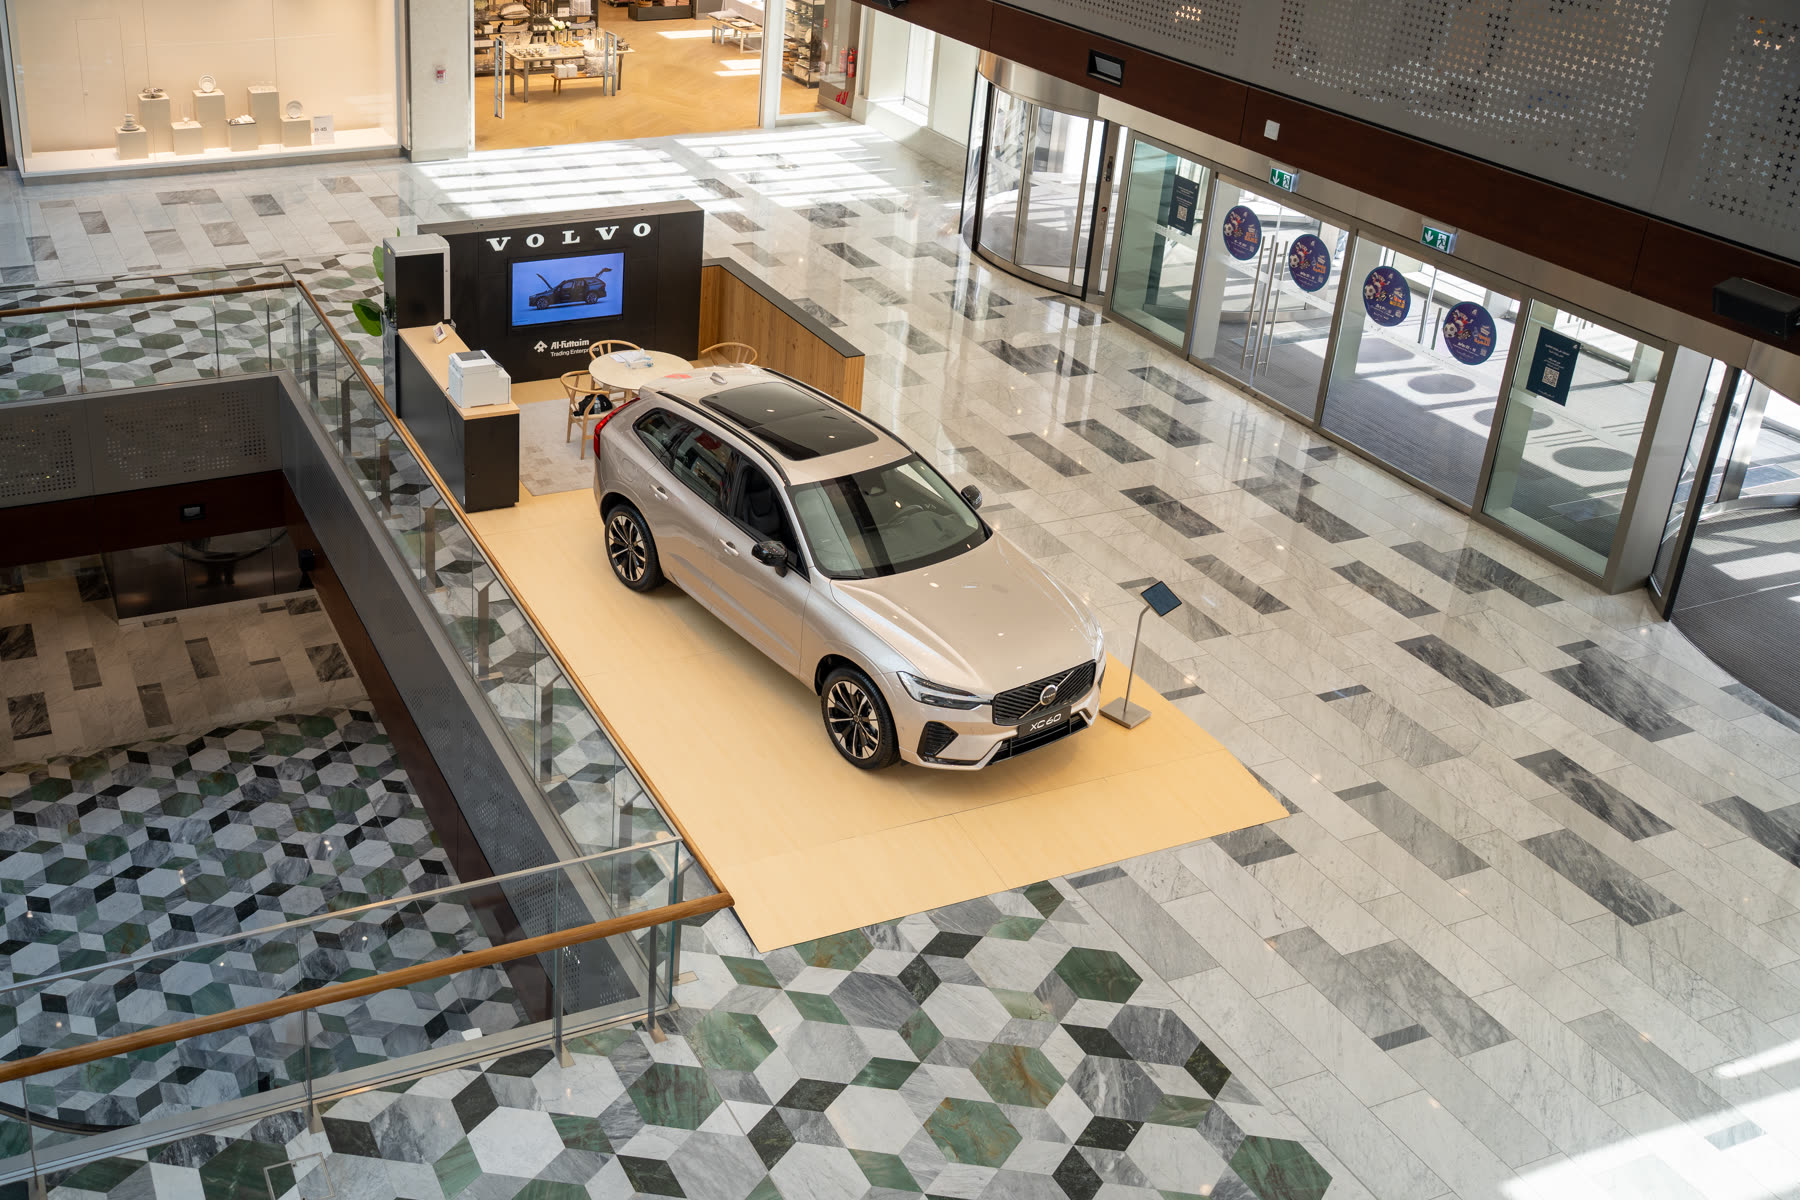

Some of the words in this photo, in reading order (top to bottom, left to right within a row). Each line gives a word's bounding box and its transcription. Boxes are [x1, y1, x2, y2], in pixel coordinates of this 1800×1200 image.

[486, 222, 652, 252] VOLVO
[550, 338, 590, 350] Al-Futtaim
[570, 347, 600, 355] Enterpres
[1029, 713, 1062, 732] XC60
